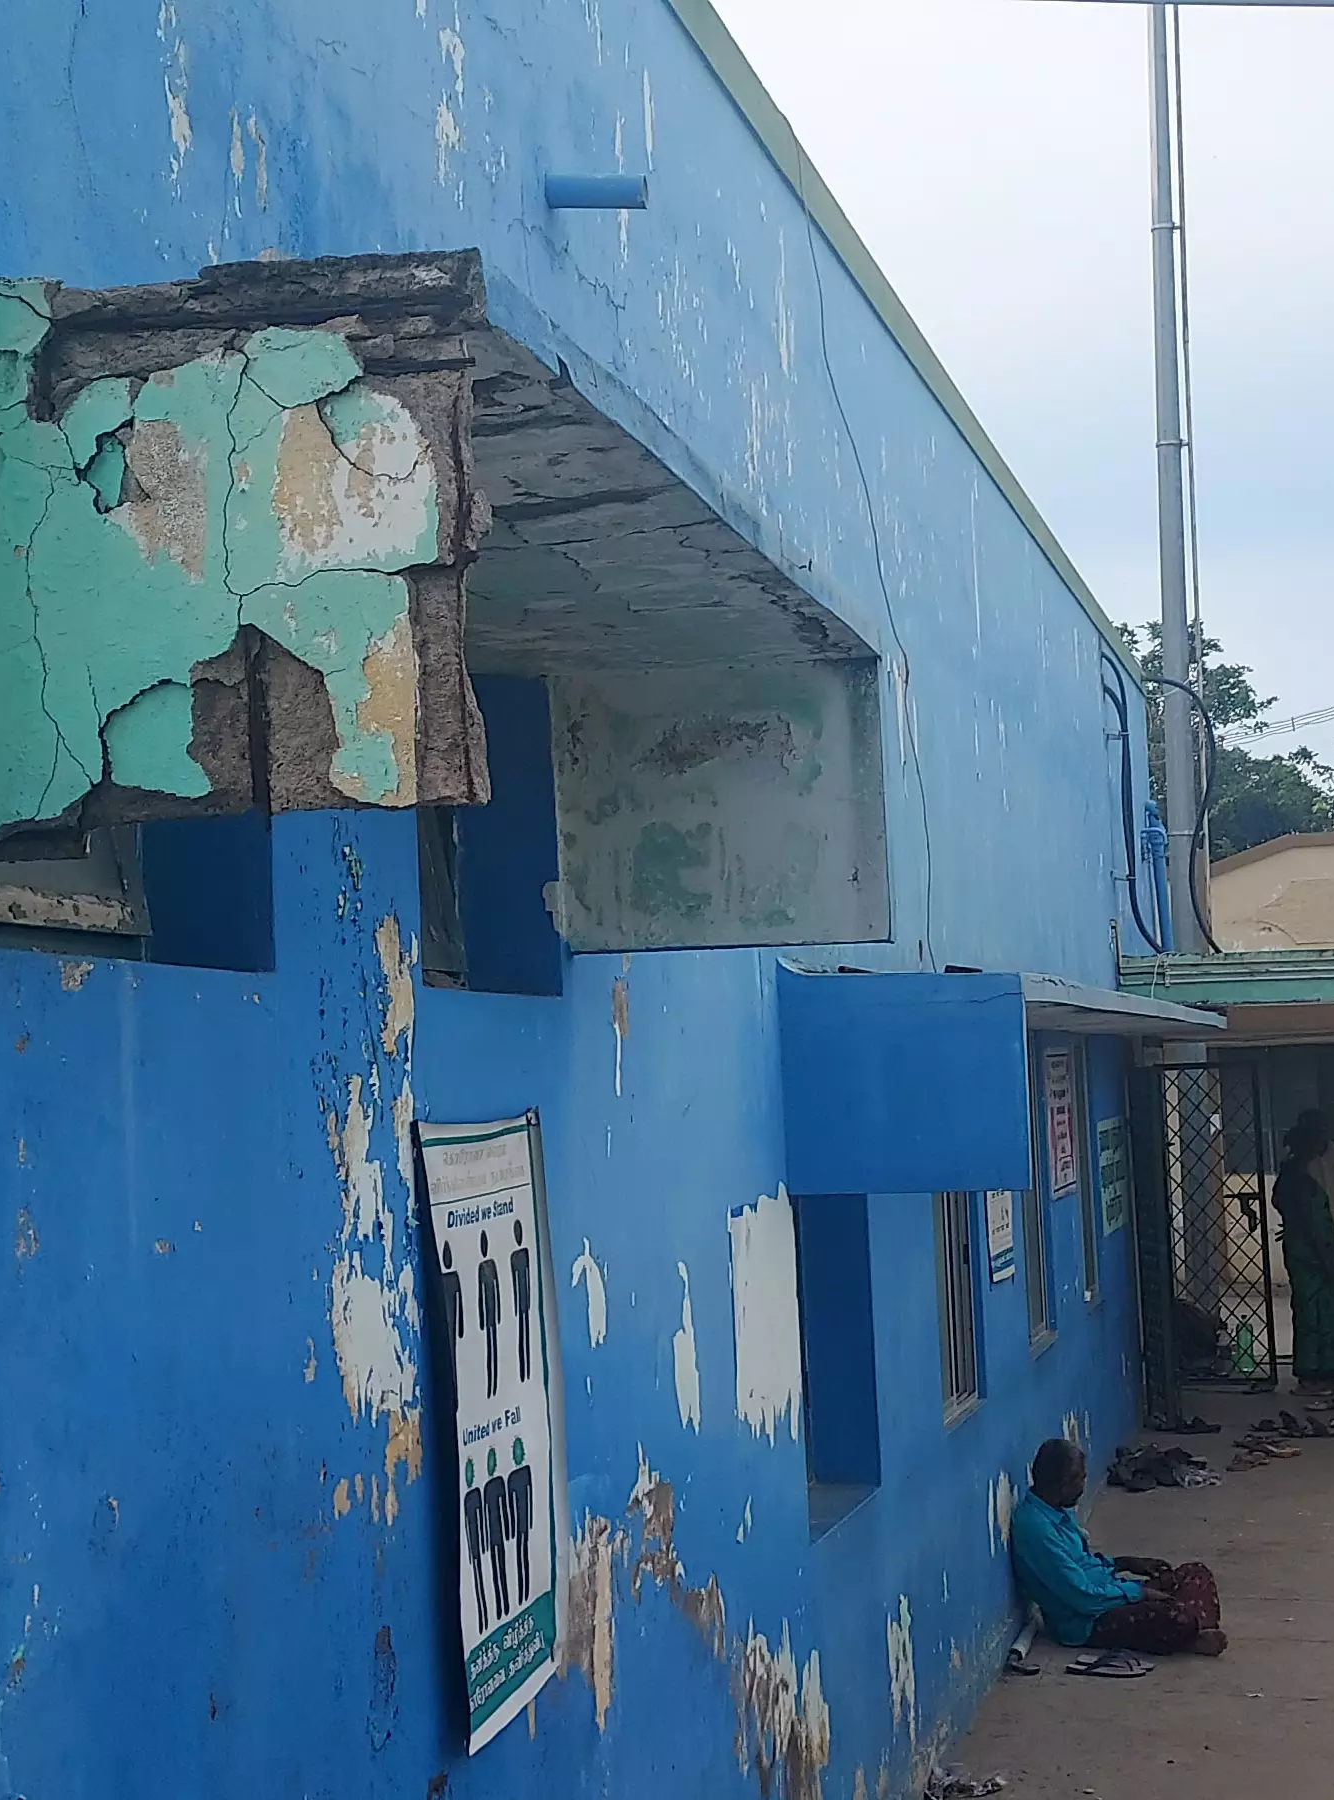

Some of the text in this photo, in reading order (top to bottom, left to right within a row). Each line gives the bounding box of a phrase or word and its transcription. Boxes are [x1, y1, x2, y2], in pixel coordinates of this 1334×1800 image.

[447, 1196, 514, 1229] Divided we Stand
[462, 1418, 491, 1446] United
[504, 1405, 521, 1428] Fall
